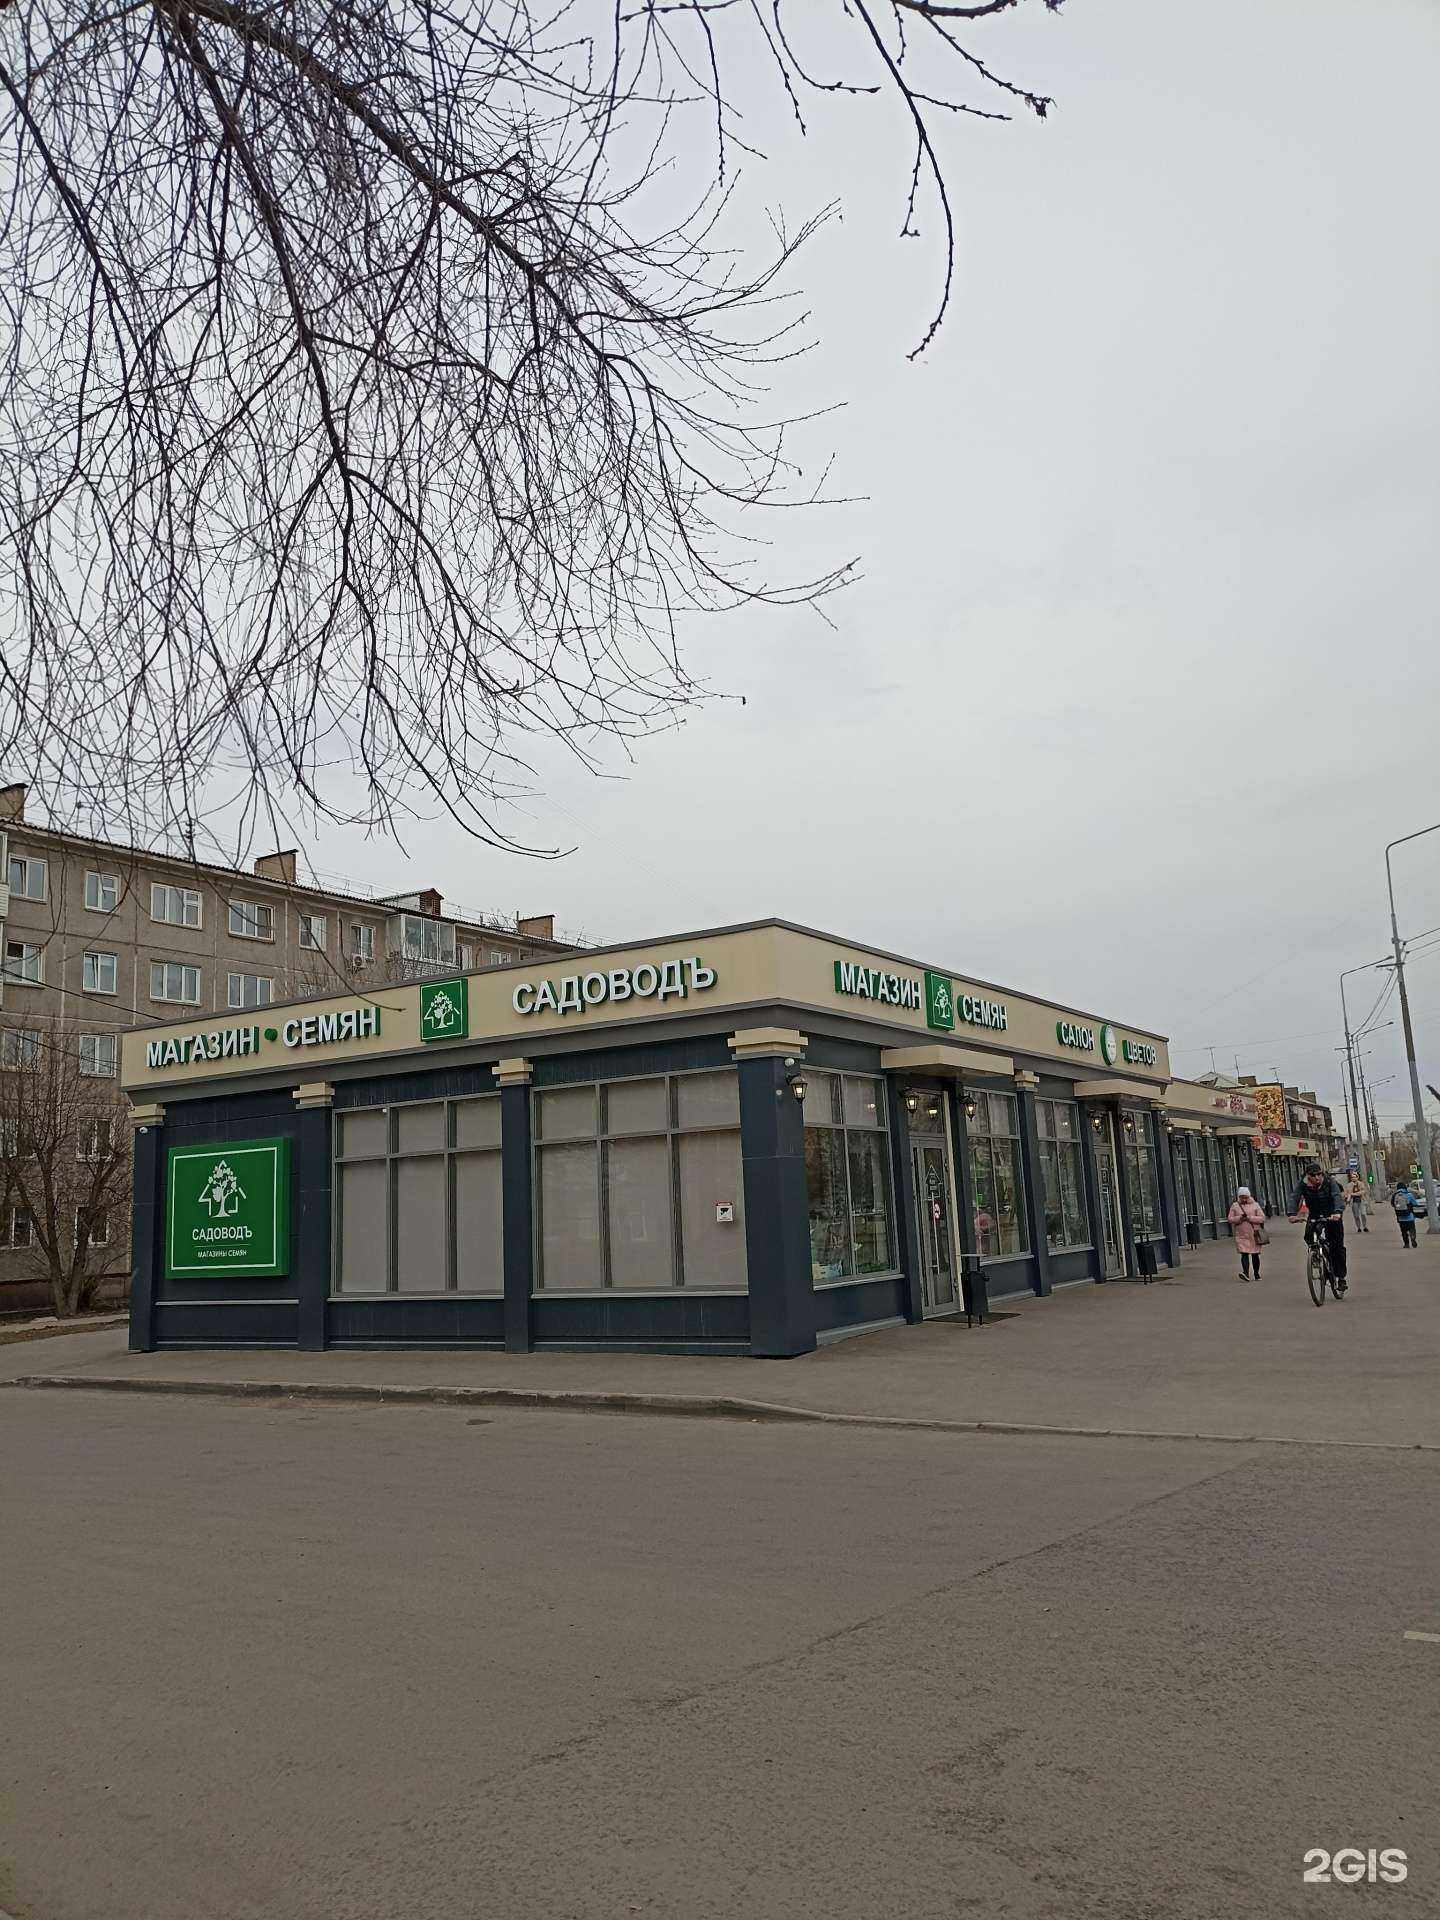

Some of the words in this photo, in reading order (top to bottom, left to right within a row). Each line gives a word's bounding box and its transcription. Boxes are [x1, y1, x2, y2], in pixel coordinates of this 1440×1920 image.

[512, 957, 718, 1015] САДОВОДЪ
[835, 960, 922, 1010] МАГАЗИН
[958, 994, 1008, 1031] СЕМЯН
[146, 1026, 259, 1068] МАГАЗИН
[282, 1006, 381, 1048] СЕМЯН
[192, 1226, 253, 1242] САДОВОДЪ
[197, 1249, 228, 1258] МАГАЗИНЫ
[228, 1248, 248, 1257] СЕМЯН
